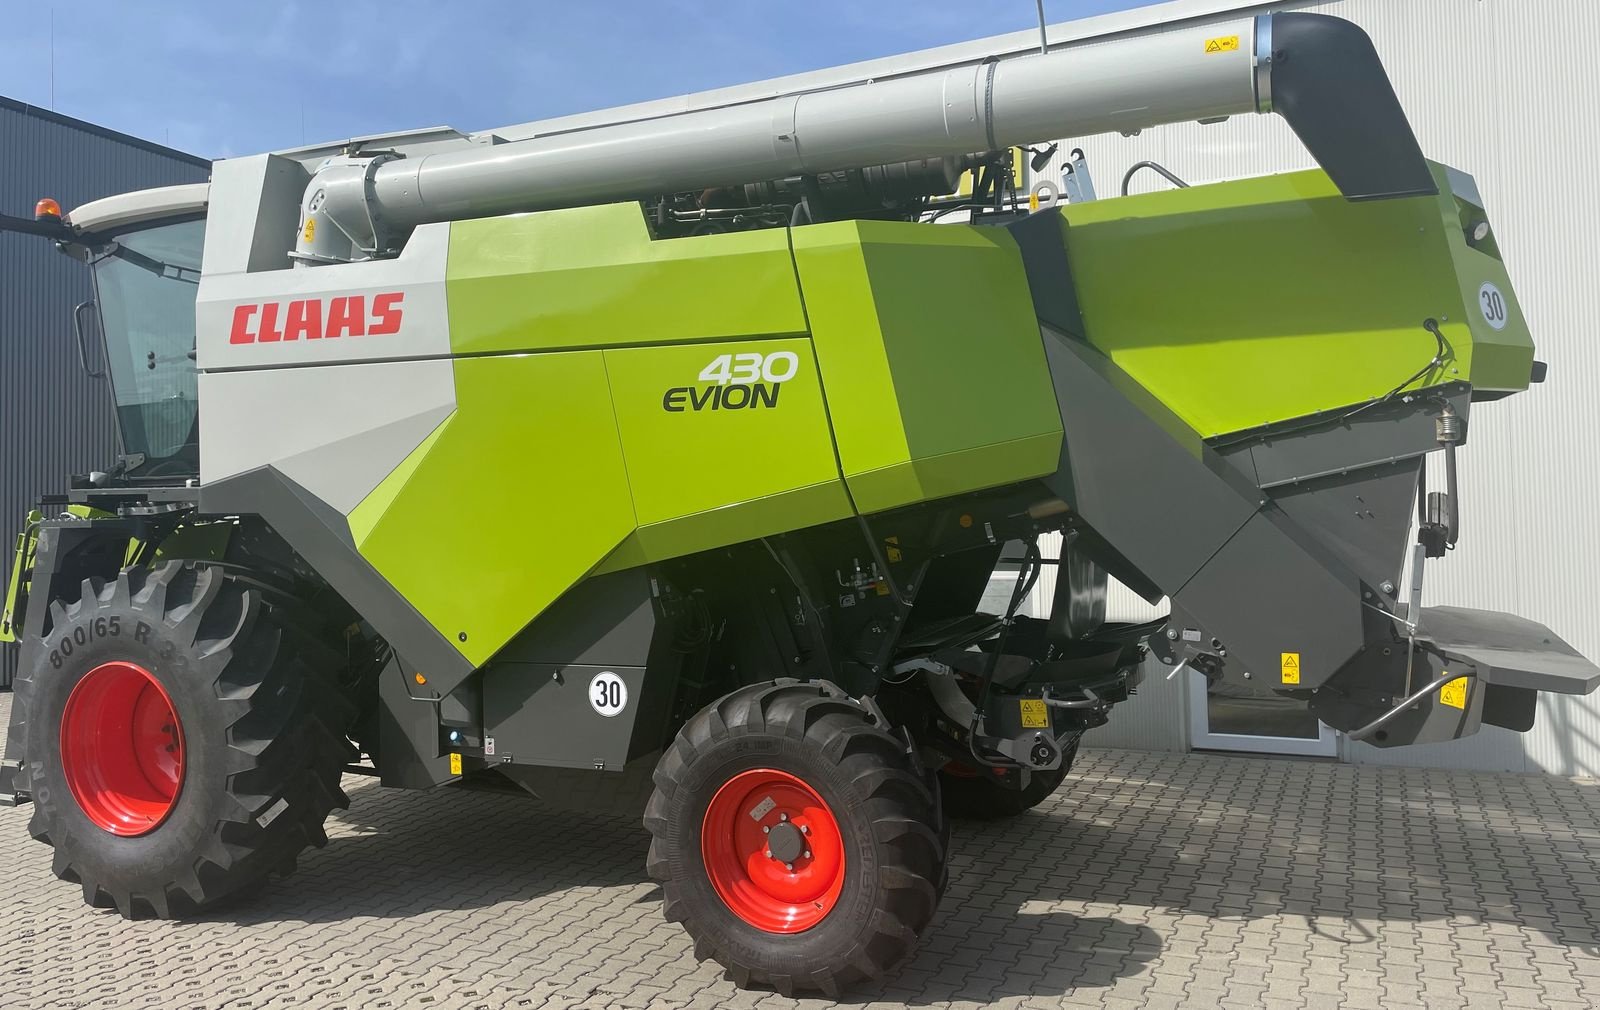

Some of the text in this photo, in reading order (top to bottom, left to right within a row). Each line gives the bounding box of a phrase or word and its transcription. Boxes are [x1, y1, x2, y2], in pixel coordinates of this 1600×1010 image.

[230, 292, 404, 345] CLAAS
[1482, 291, 1504, 321] 30
[698, 351, 799, 385] 430
[662, 383, 781, 412] EVION
[50, 615, 121, 669] 800/65
[134, 620, 153, 645] R
[595, 680, 620, 708] 30
